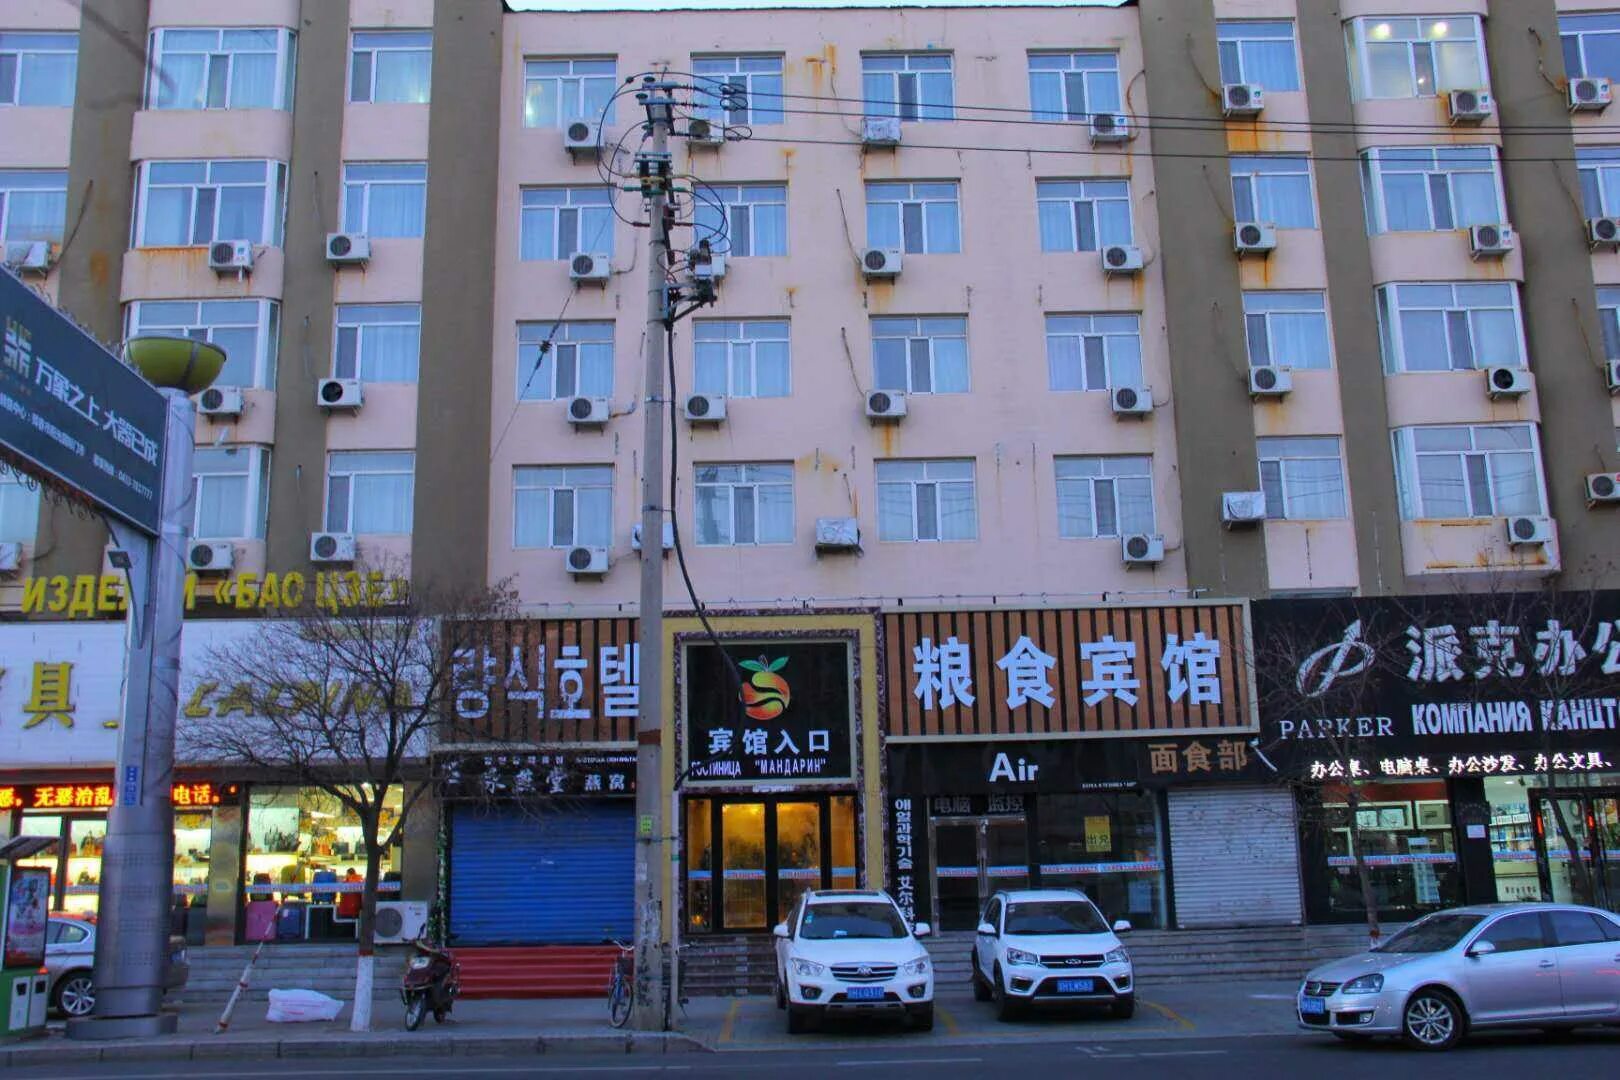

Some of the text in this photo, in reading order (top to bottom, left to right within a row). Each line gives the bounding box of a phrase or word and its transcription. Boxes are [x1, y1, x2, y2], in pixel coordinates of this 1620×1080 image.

[215, 571, 305, 610] «БАО
[913, 632, 1222, 711] 粮食宾馆
[1279, 716, 1394, 740] PARKER
[1411, 701, 1533, 735] КОМПАНИЯ
[708, 727, 830, 755] 宾馆入口
[1147, 739, 1248, 774] 面食部
[988, 752, 1040, 782] Air
